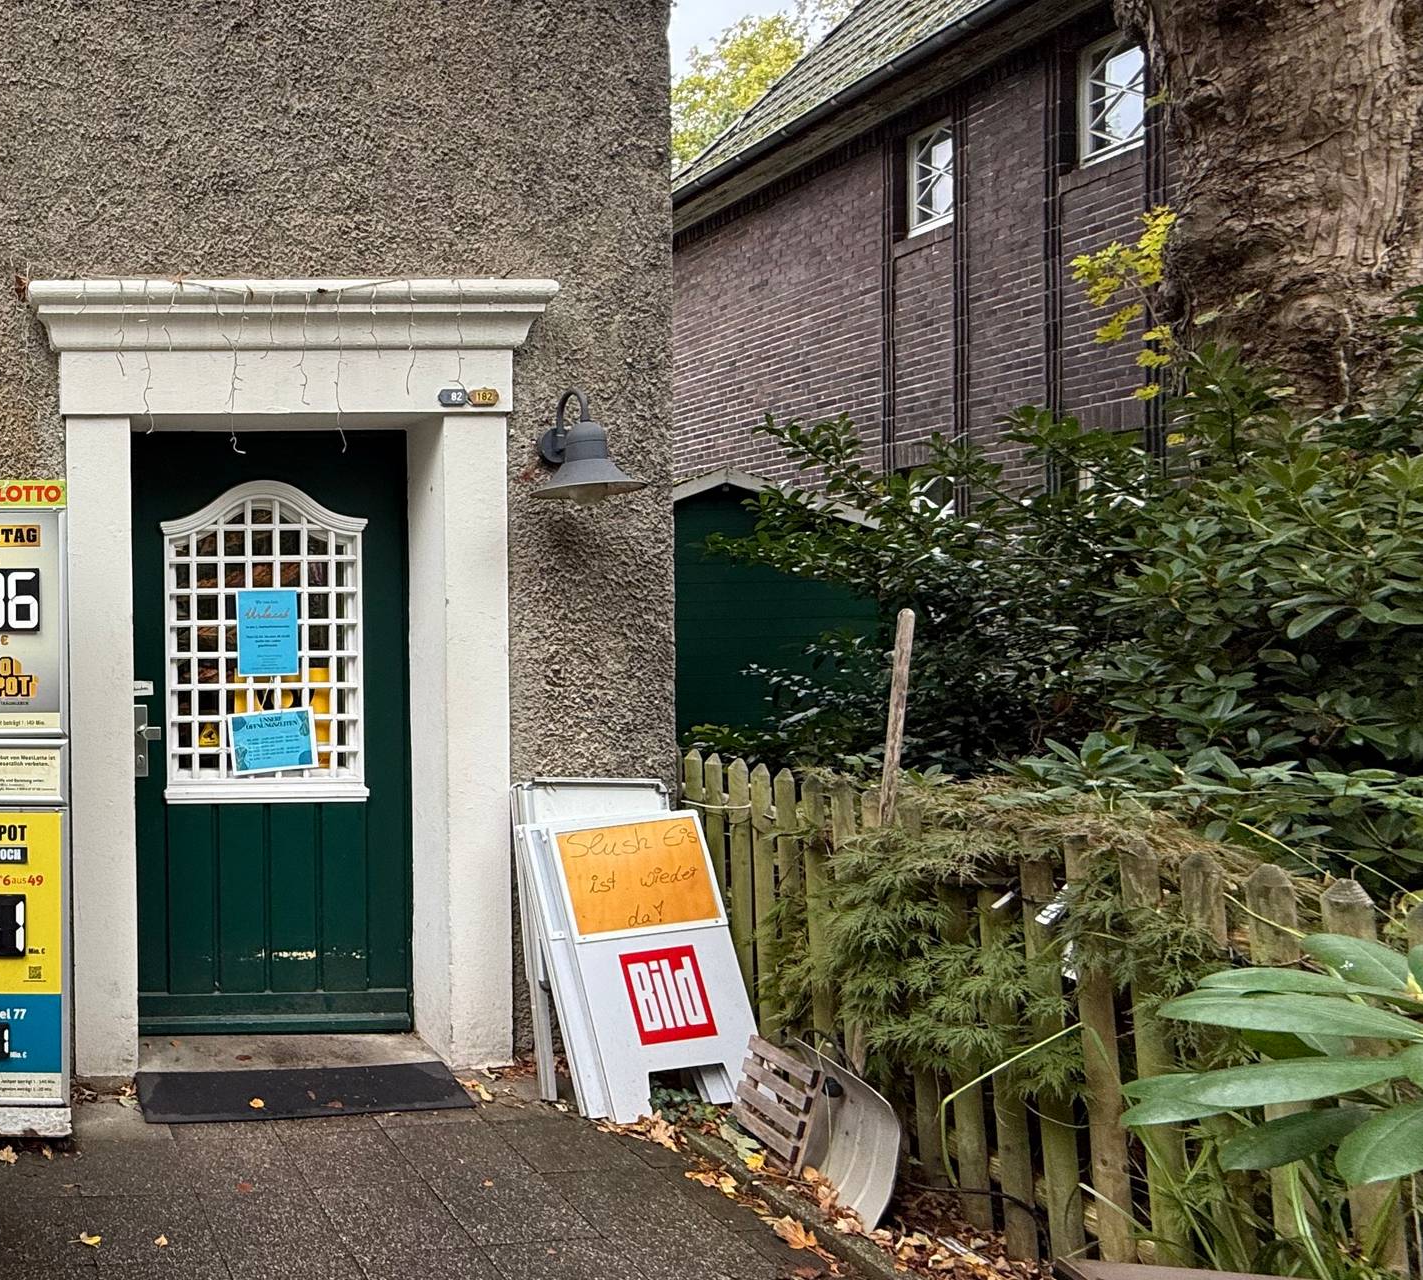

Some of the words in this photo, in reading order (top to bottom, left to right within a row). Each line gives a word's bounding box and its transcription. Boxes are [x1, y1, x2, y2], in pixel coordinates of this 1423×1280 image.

[476, 392, 493, 401] 182
[567, 827, 653, 859] Slush
[662, 823, 699, 847] Eis
[589, 870, 616, 894] ist
[639, 865, 699, 888] wieder
[628, 900, 664, 928] da!
[627, 955, 708, 1032] Bild
[13, 1008, 27, 1020] 77
